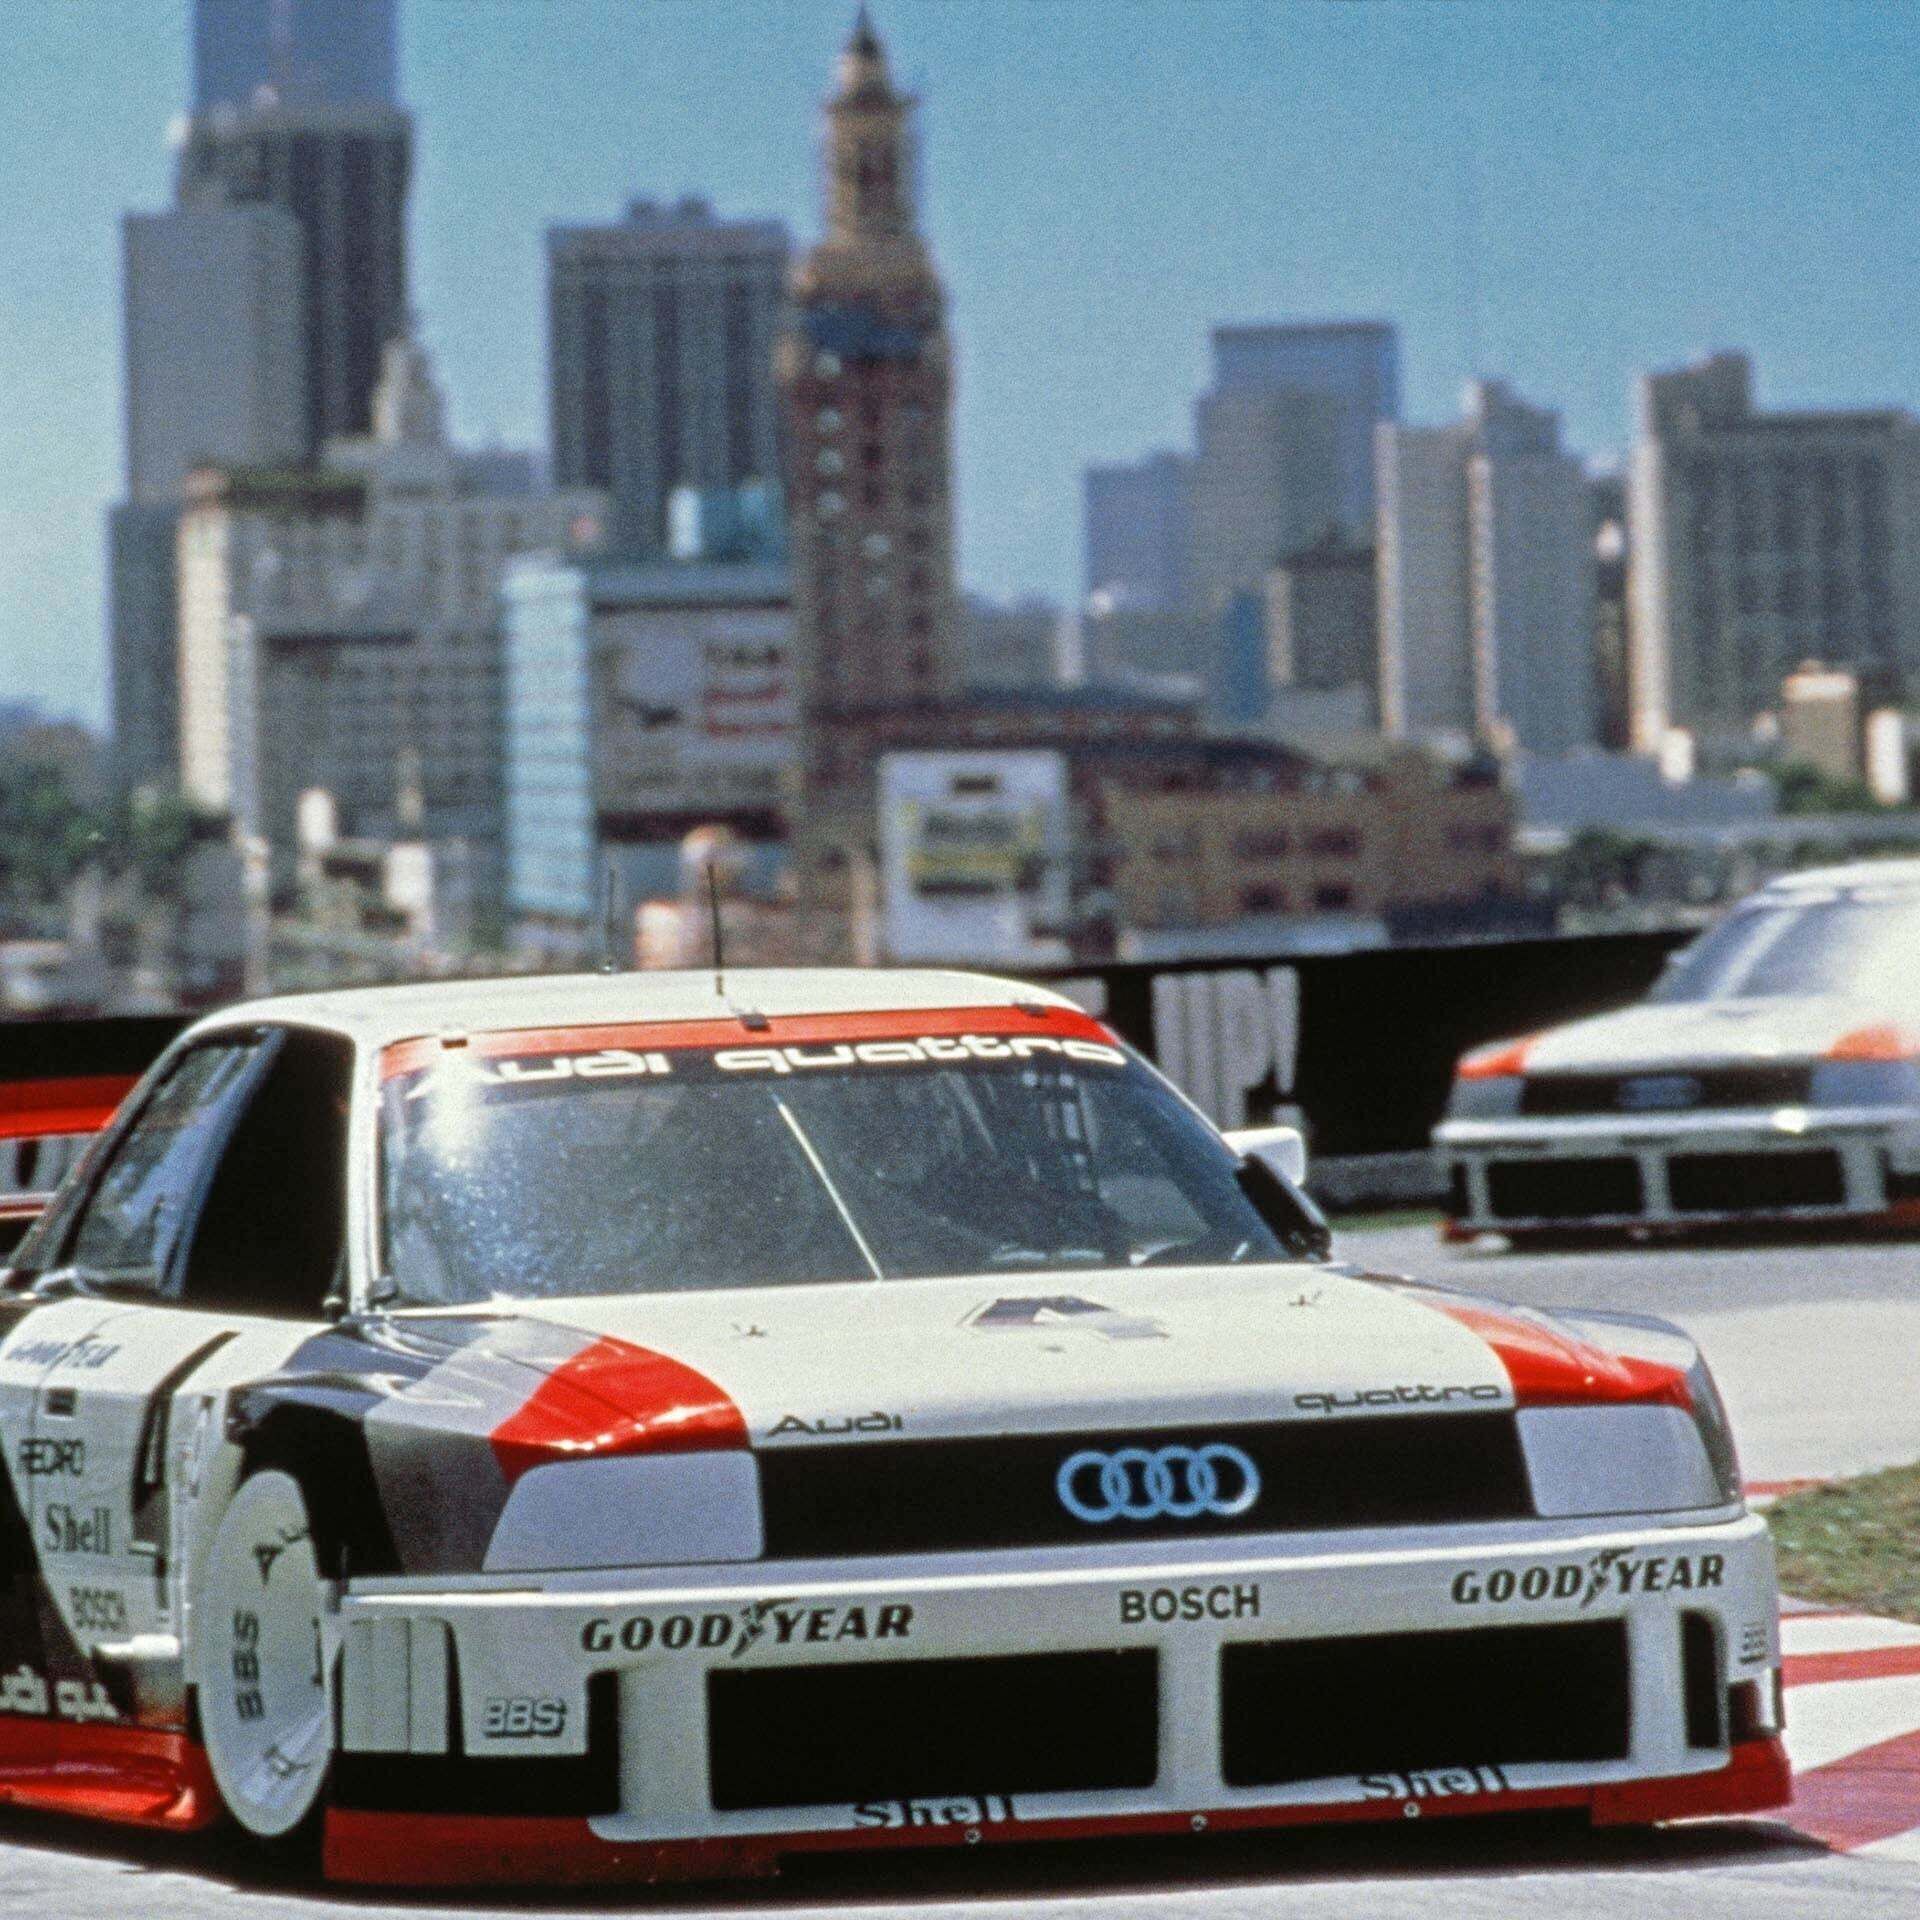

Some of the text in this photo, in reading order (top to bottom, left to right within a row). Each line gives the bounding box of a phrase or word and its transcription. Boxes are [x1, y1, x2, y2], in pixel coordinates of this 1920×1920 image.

[714, 1034, 1127, 1074] quattro
[1294, 1384, 1502, 1413] quattro
[767, 1410, 904, 1437] Audi
[45, 1502, 111, 1555] Shell
[1120, 1583, 1261, 1624] BOSCH
[485, 1696, 567, 1738] BBS
[1358, 1765, 1509, 1799] Shell
[853, 1794, 1015, 1828] Shell
